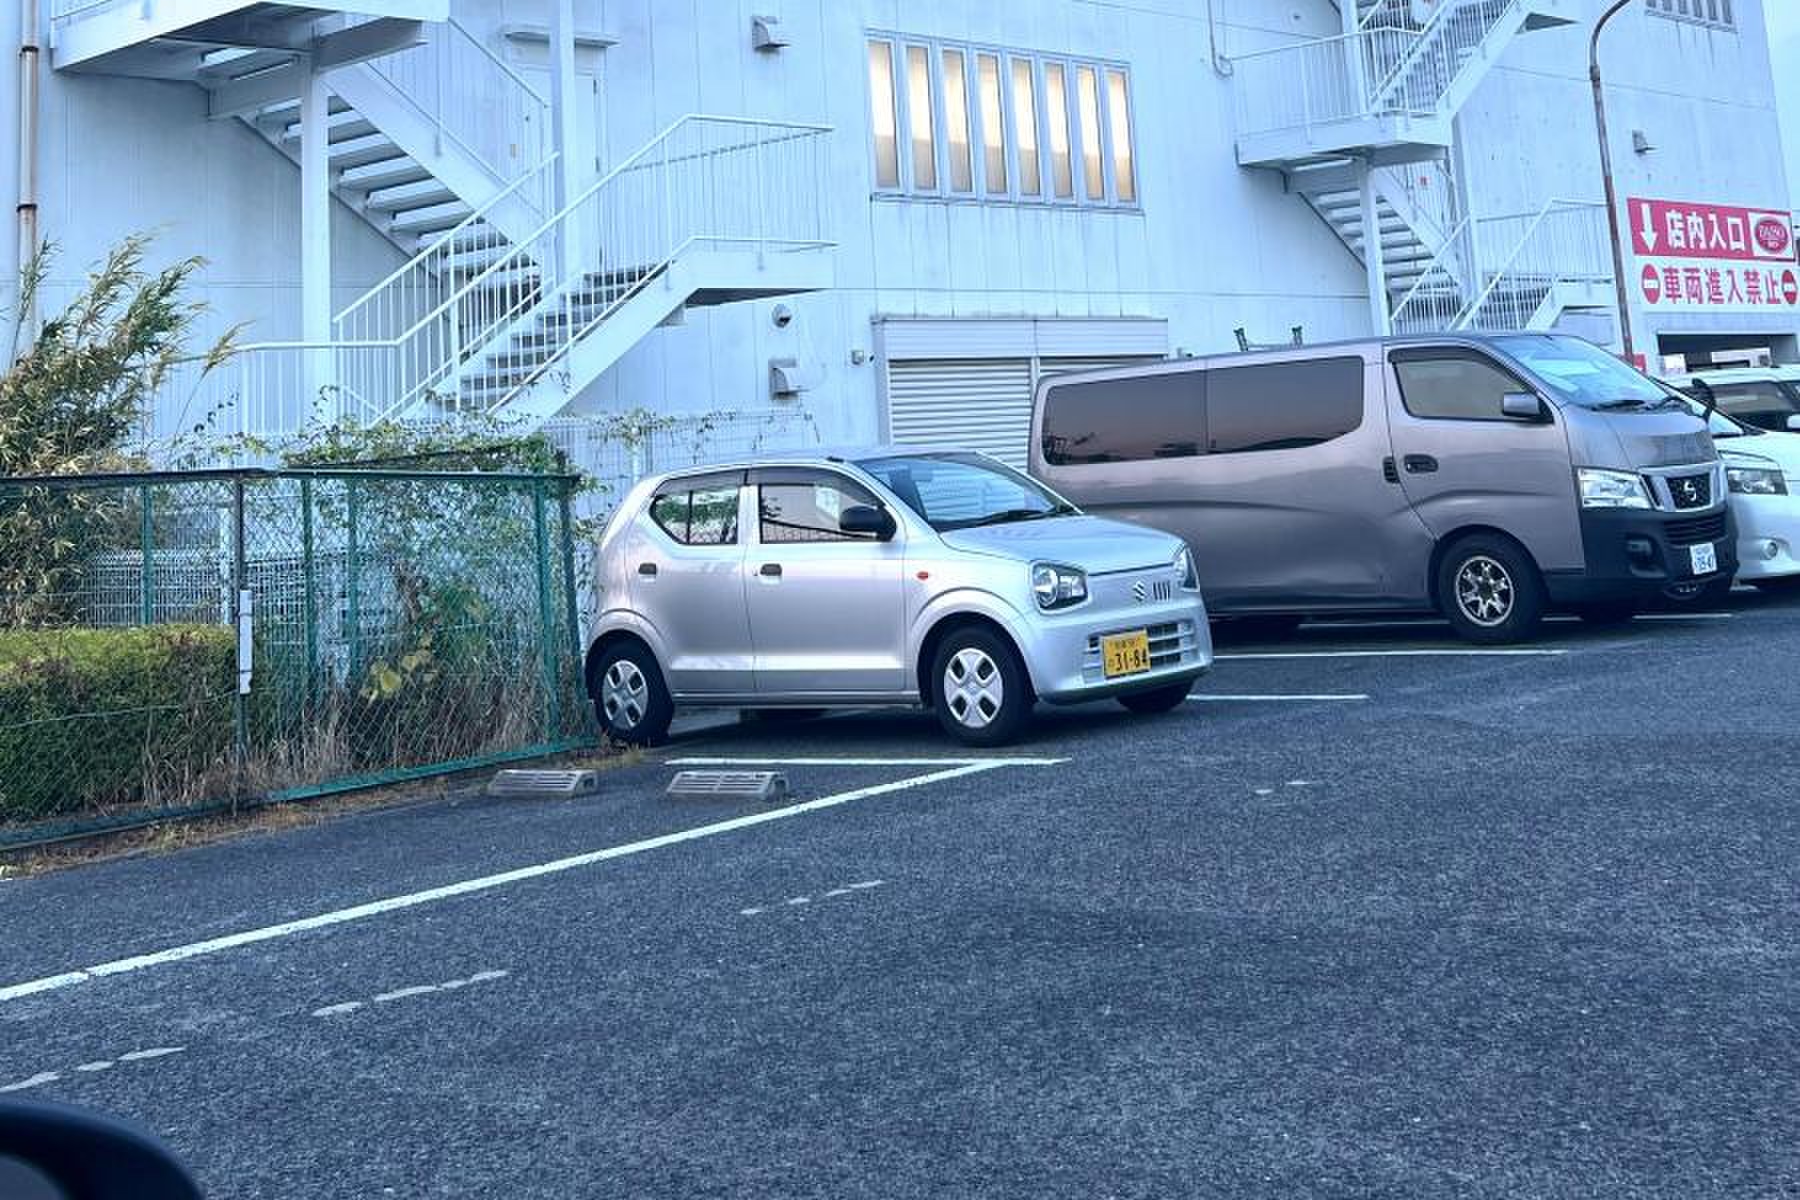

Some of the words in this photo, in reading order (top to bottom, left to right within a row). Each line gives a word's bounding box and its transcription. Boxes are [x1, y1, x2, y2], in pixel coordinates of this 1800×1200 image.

[1664, 209, 1746, 251] 店内入口
[1662, 267, 1781, 305] 車両進入禁止
